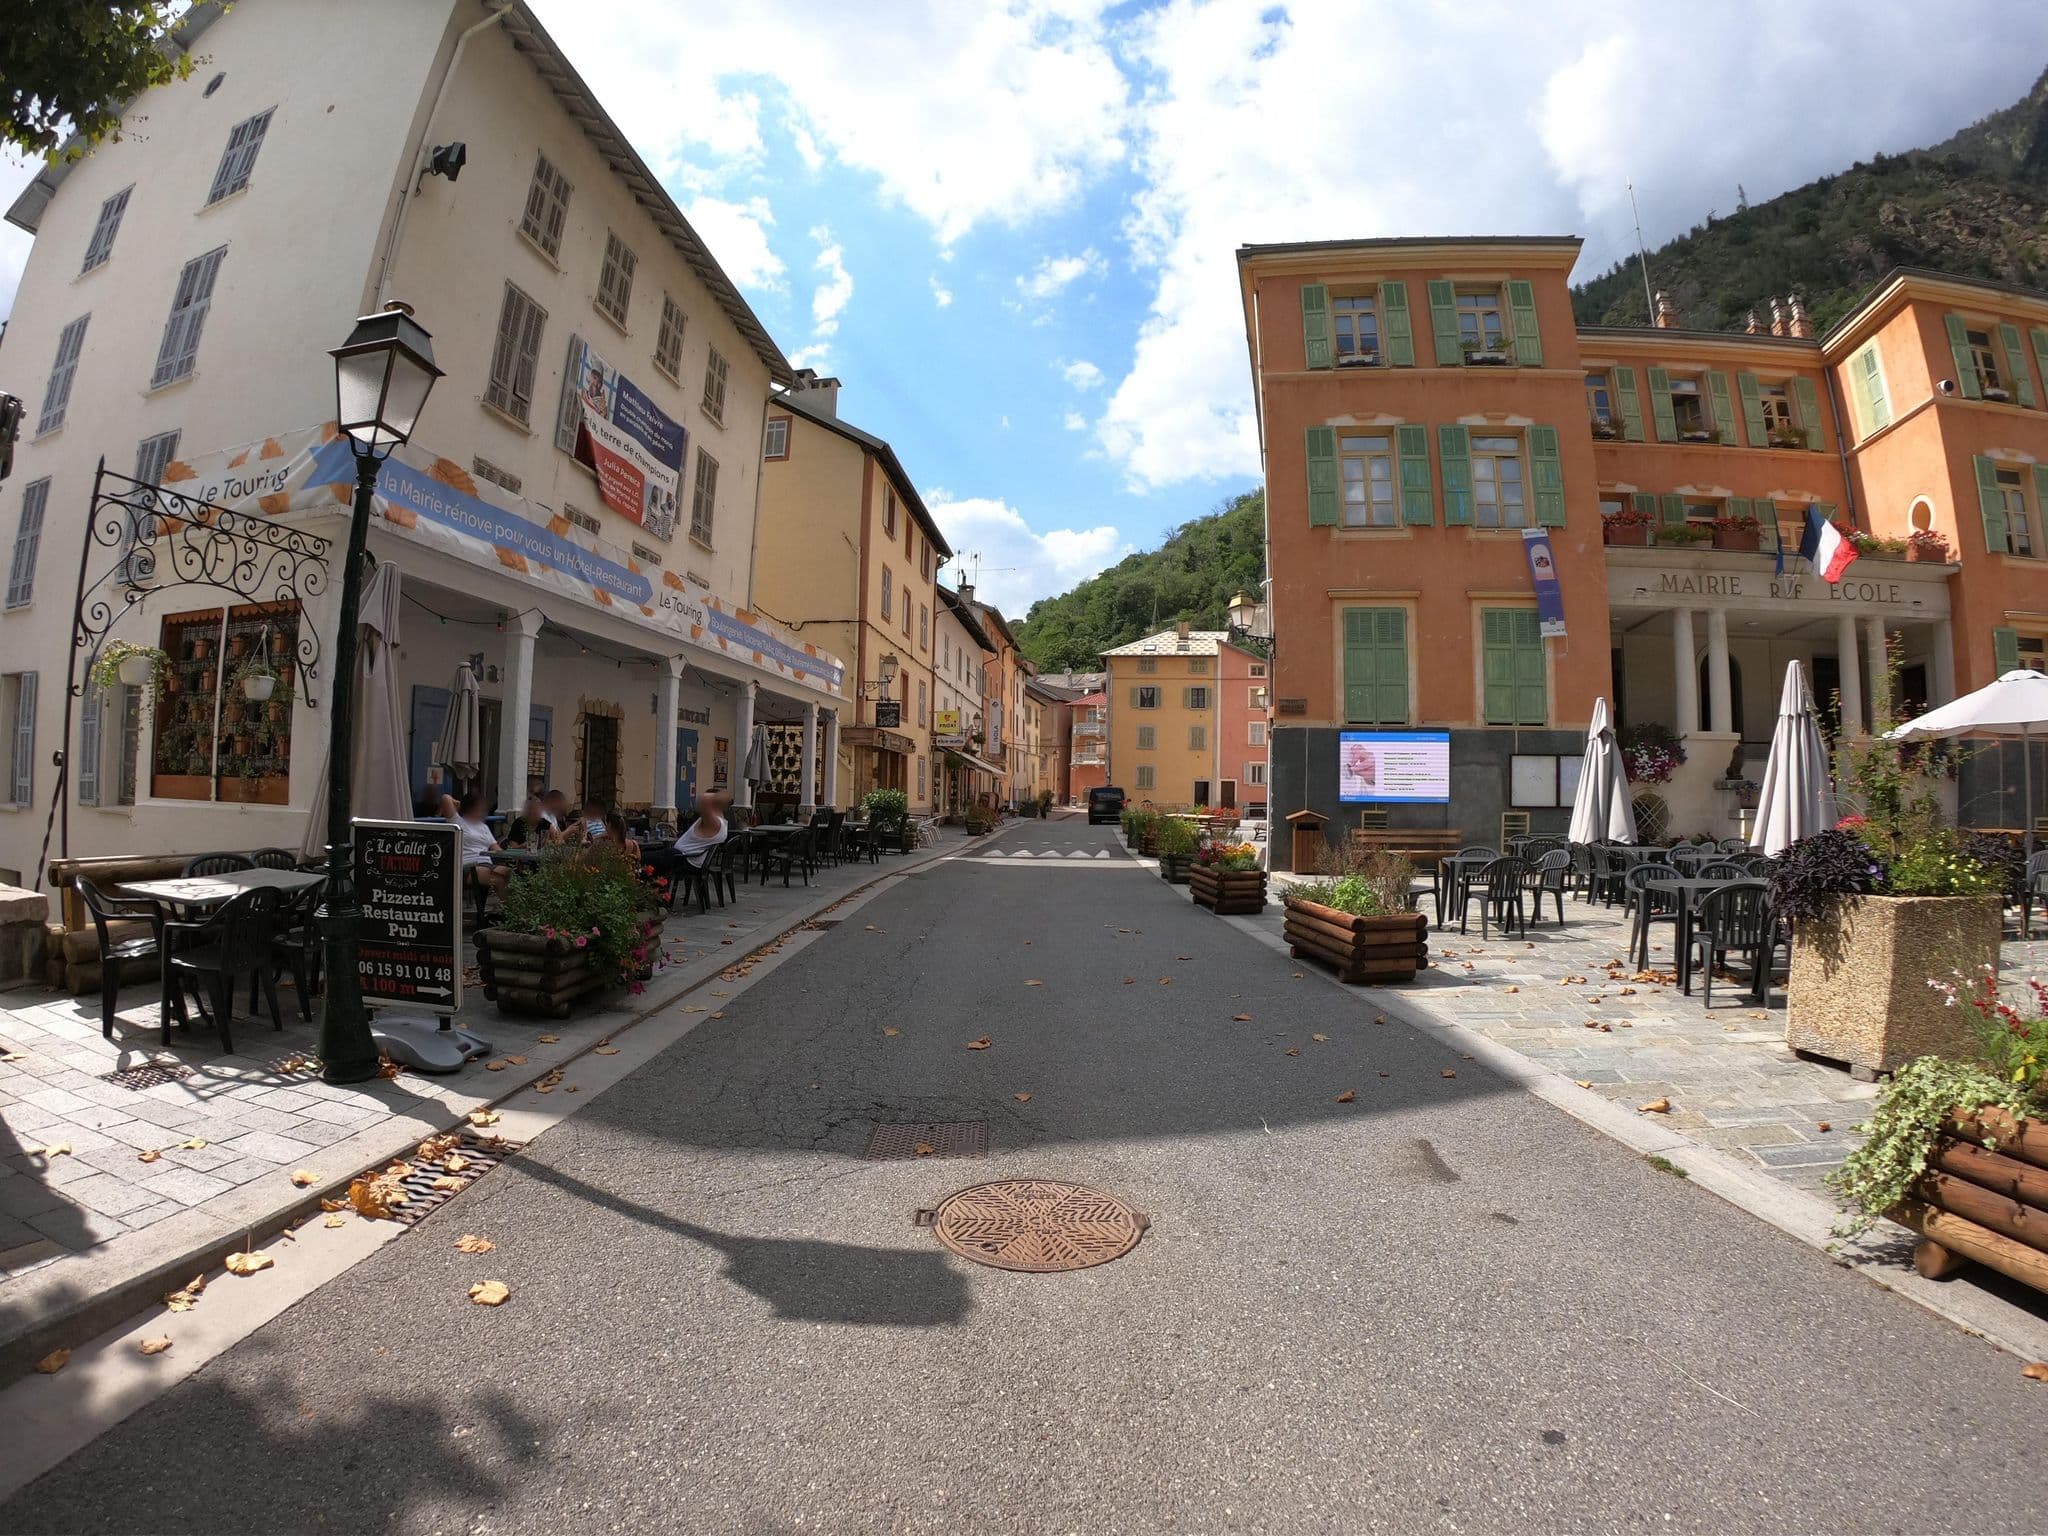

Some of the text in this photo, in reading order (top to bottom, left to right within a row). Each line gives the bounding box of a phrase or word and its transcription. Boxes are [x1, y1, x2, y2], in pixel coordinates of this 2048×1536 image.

[600, 427, 622, 447] terre
[623, 442, 635, 456] de
[635, 452, 670, 484] champions
[603, 457, 620, 473] Julia
[223, 466, 290, 500] Touring
[384, 470, 643, 598] la Mairie rénove pour vous un Hôtel-Restaurant
[1660, 573, 1742, 596] MAIRIE
[659, 591, 703, 626] Le Touring
[376, 838, 427, 856] Le Collet
[371, 888, 435, 907] Pizzeria
[362, 904, 445, 924] Restaurant
[388, 922, 418, 938] Pub
[358, 960, 451, 982] 06 15 91 01 48
